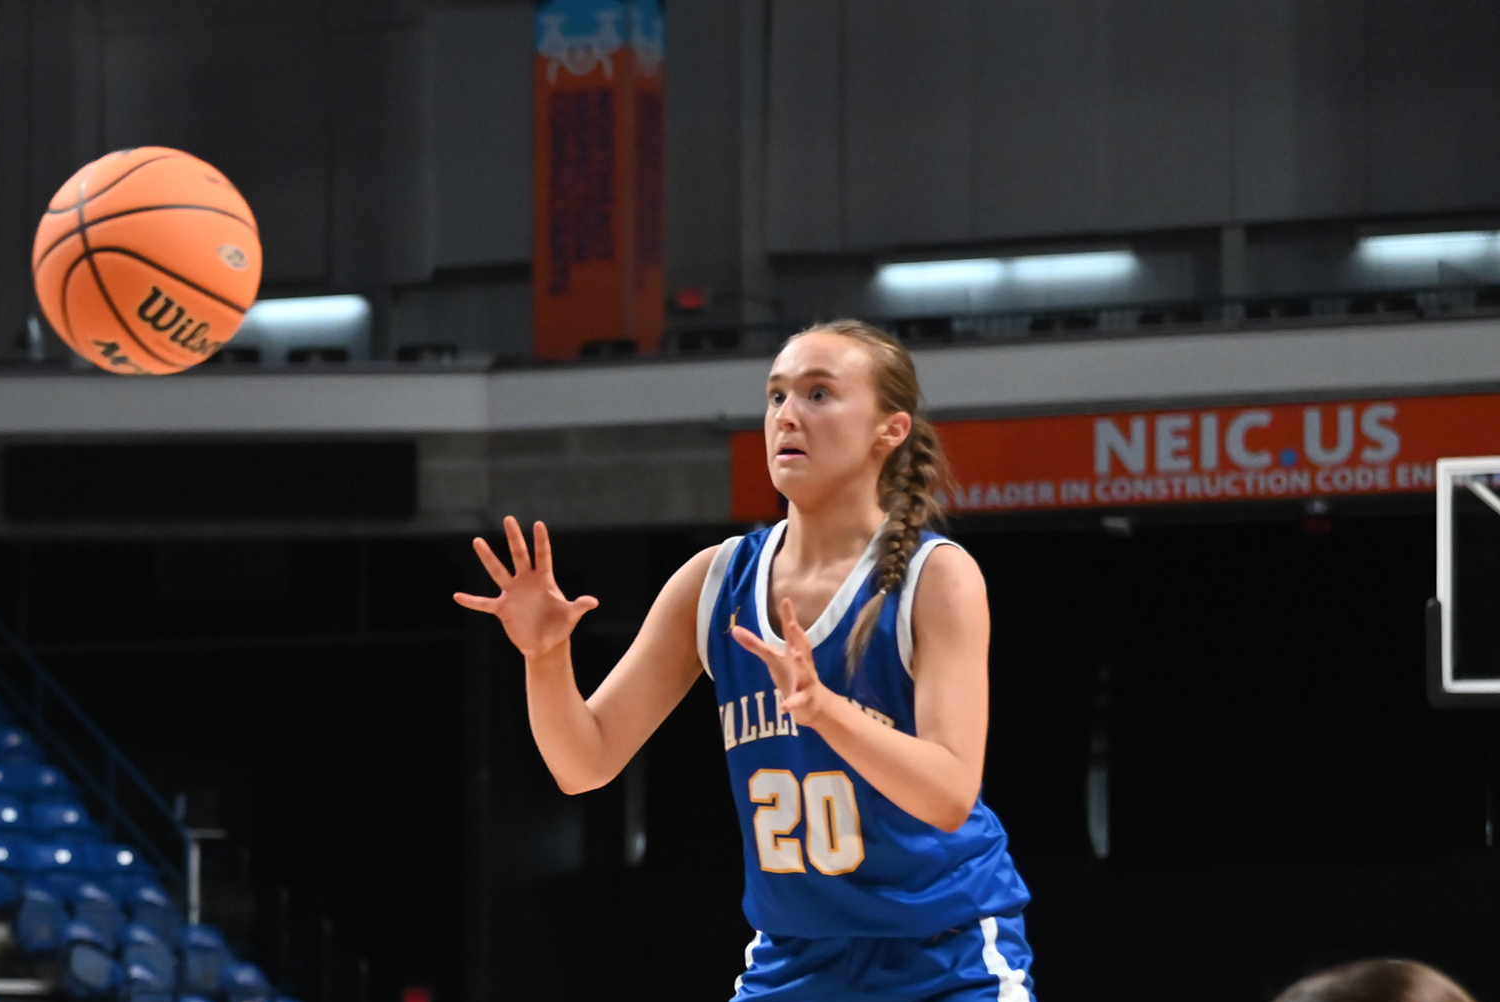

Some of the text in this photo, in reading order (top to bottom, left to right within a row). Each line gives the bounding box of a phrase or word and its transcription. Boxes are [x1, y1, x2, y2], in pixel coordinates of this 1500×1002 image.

[1094, 403, 1401, 475] NEIC.US
[955, 481, 1055, 508] LEADER
[1060, 479, 1091, 503] IN
[1095, 468, 1311, 502] CONSTRUCTION
[1316, 466, 1390, 493] CODE
[748, 768, 866, 876] 20
